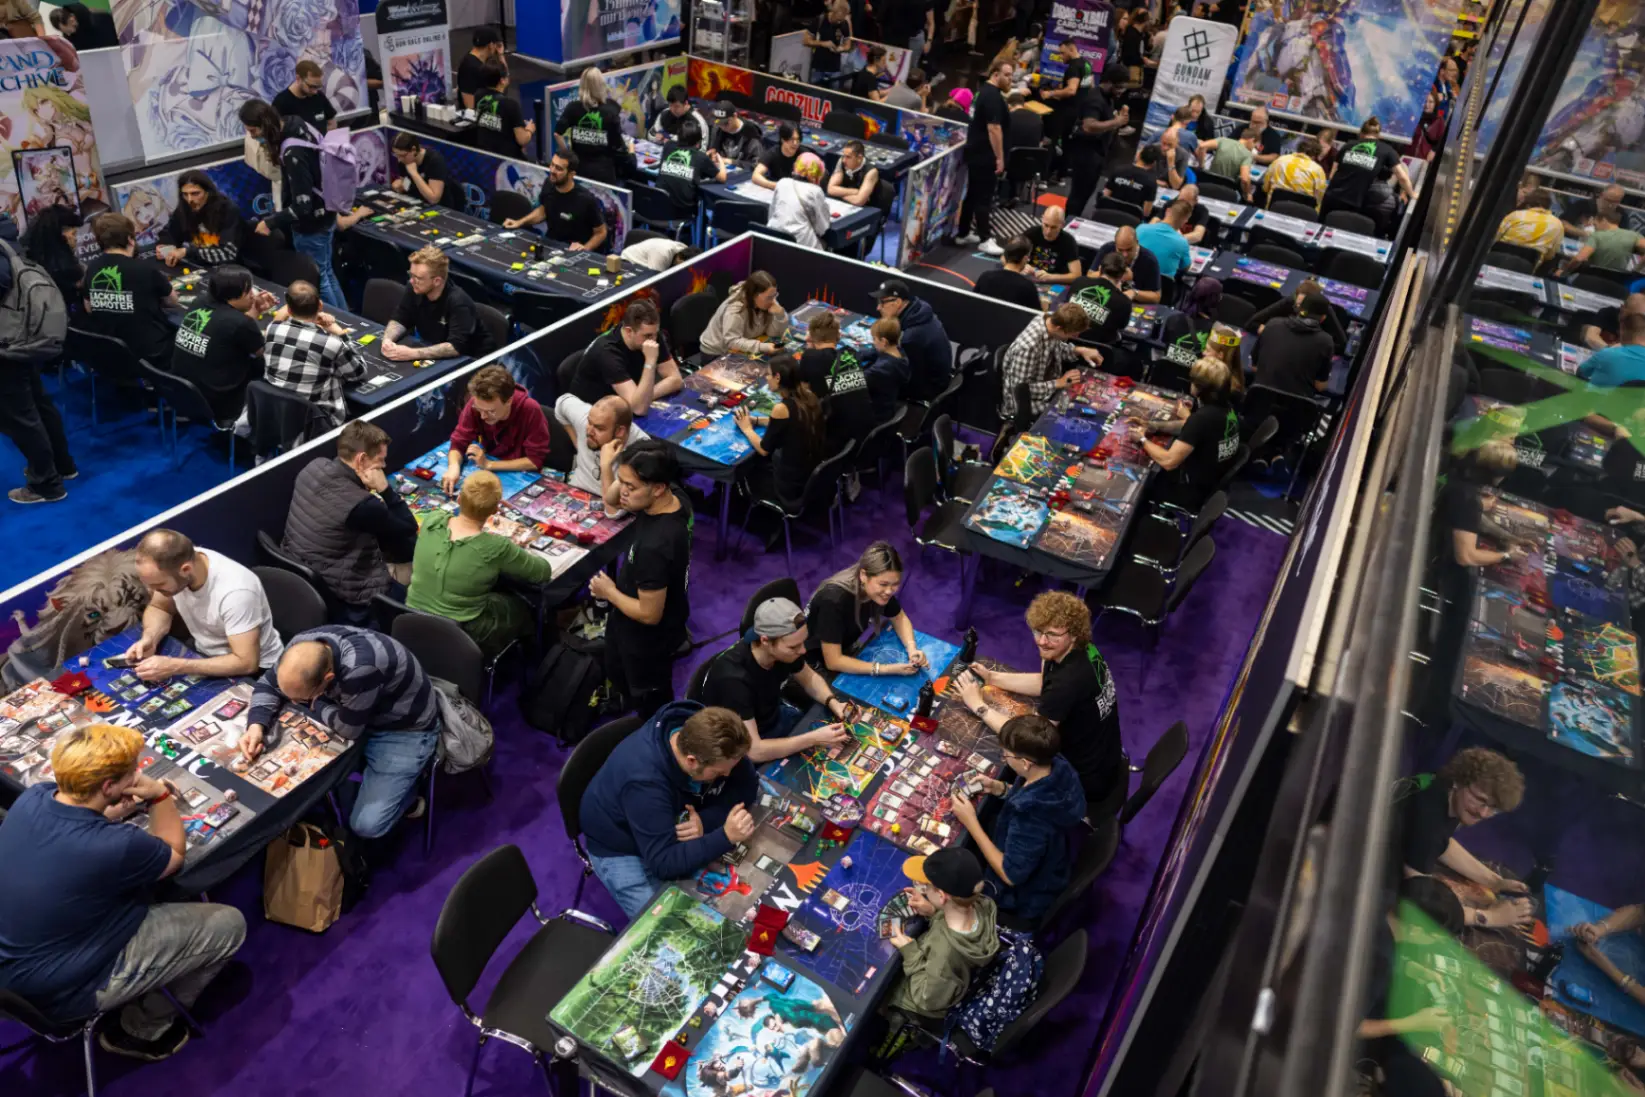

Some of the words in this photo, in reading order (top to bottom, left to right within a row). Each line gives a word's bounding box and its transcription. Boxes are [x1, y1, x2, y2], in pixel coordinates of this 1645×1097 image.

[0, 50, 54, 71] AND
[1174, 63, 1213, 81] GUNDAM
[0, 67, 68, 92] CHIVE
[765, 86, 833, 123] GODZILLA
